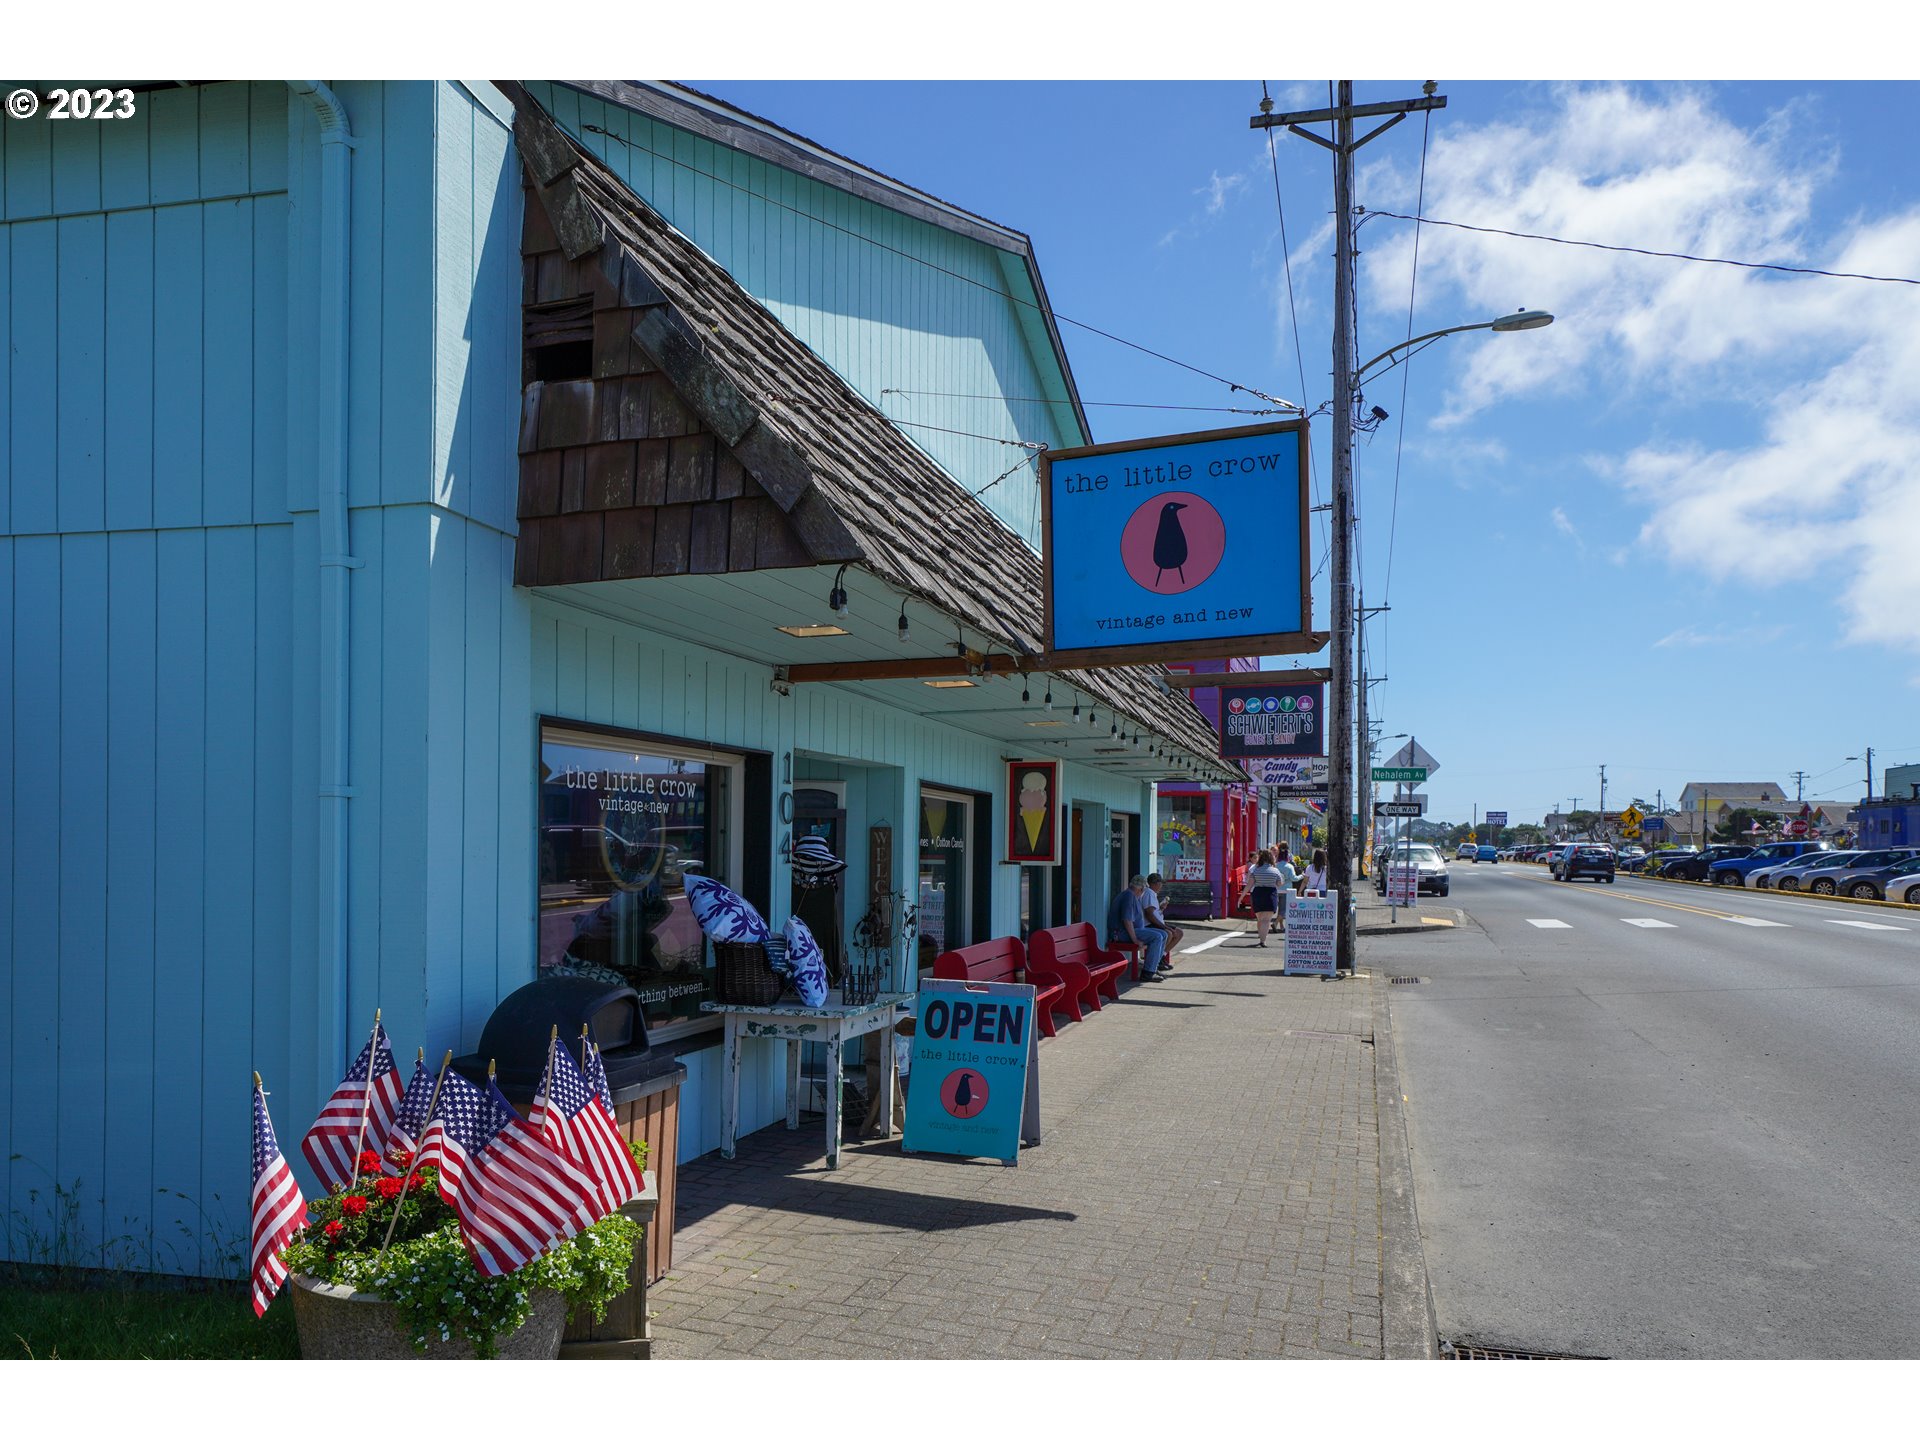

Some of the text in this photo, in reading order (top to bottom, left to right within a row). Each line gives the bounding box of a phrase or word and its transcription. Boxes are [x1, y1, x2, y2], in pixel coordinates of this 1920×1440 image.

[1065, 453, 1281, 494] the little crow
[1096, 607, 1254, 630] vintage and new
[1228, 712, 1314, 736] SCHWIETERT'S
[1244, 733, 1296, 745] CONES & CANDY
[1265, 761, 1298, 772] Candy
[1374, 771, 1411, 779] Nehalem
[565, 765, 697, 799] the little crow
[1264, 774, 1296, 783] Gifts
[598, 797, 644, 815] vintage
[650, 801, 670, 814] new
[779, 752, 795, 864] 104
[936, 836, 951, 848] Cotton
[1289, 909, 1334, 919] SCHWIETERT'S
[924, 1000, 1024, 1045] OPEN
[921, 1049, 1019, 1067] the little crow
